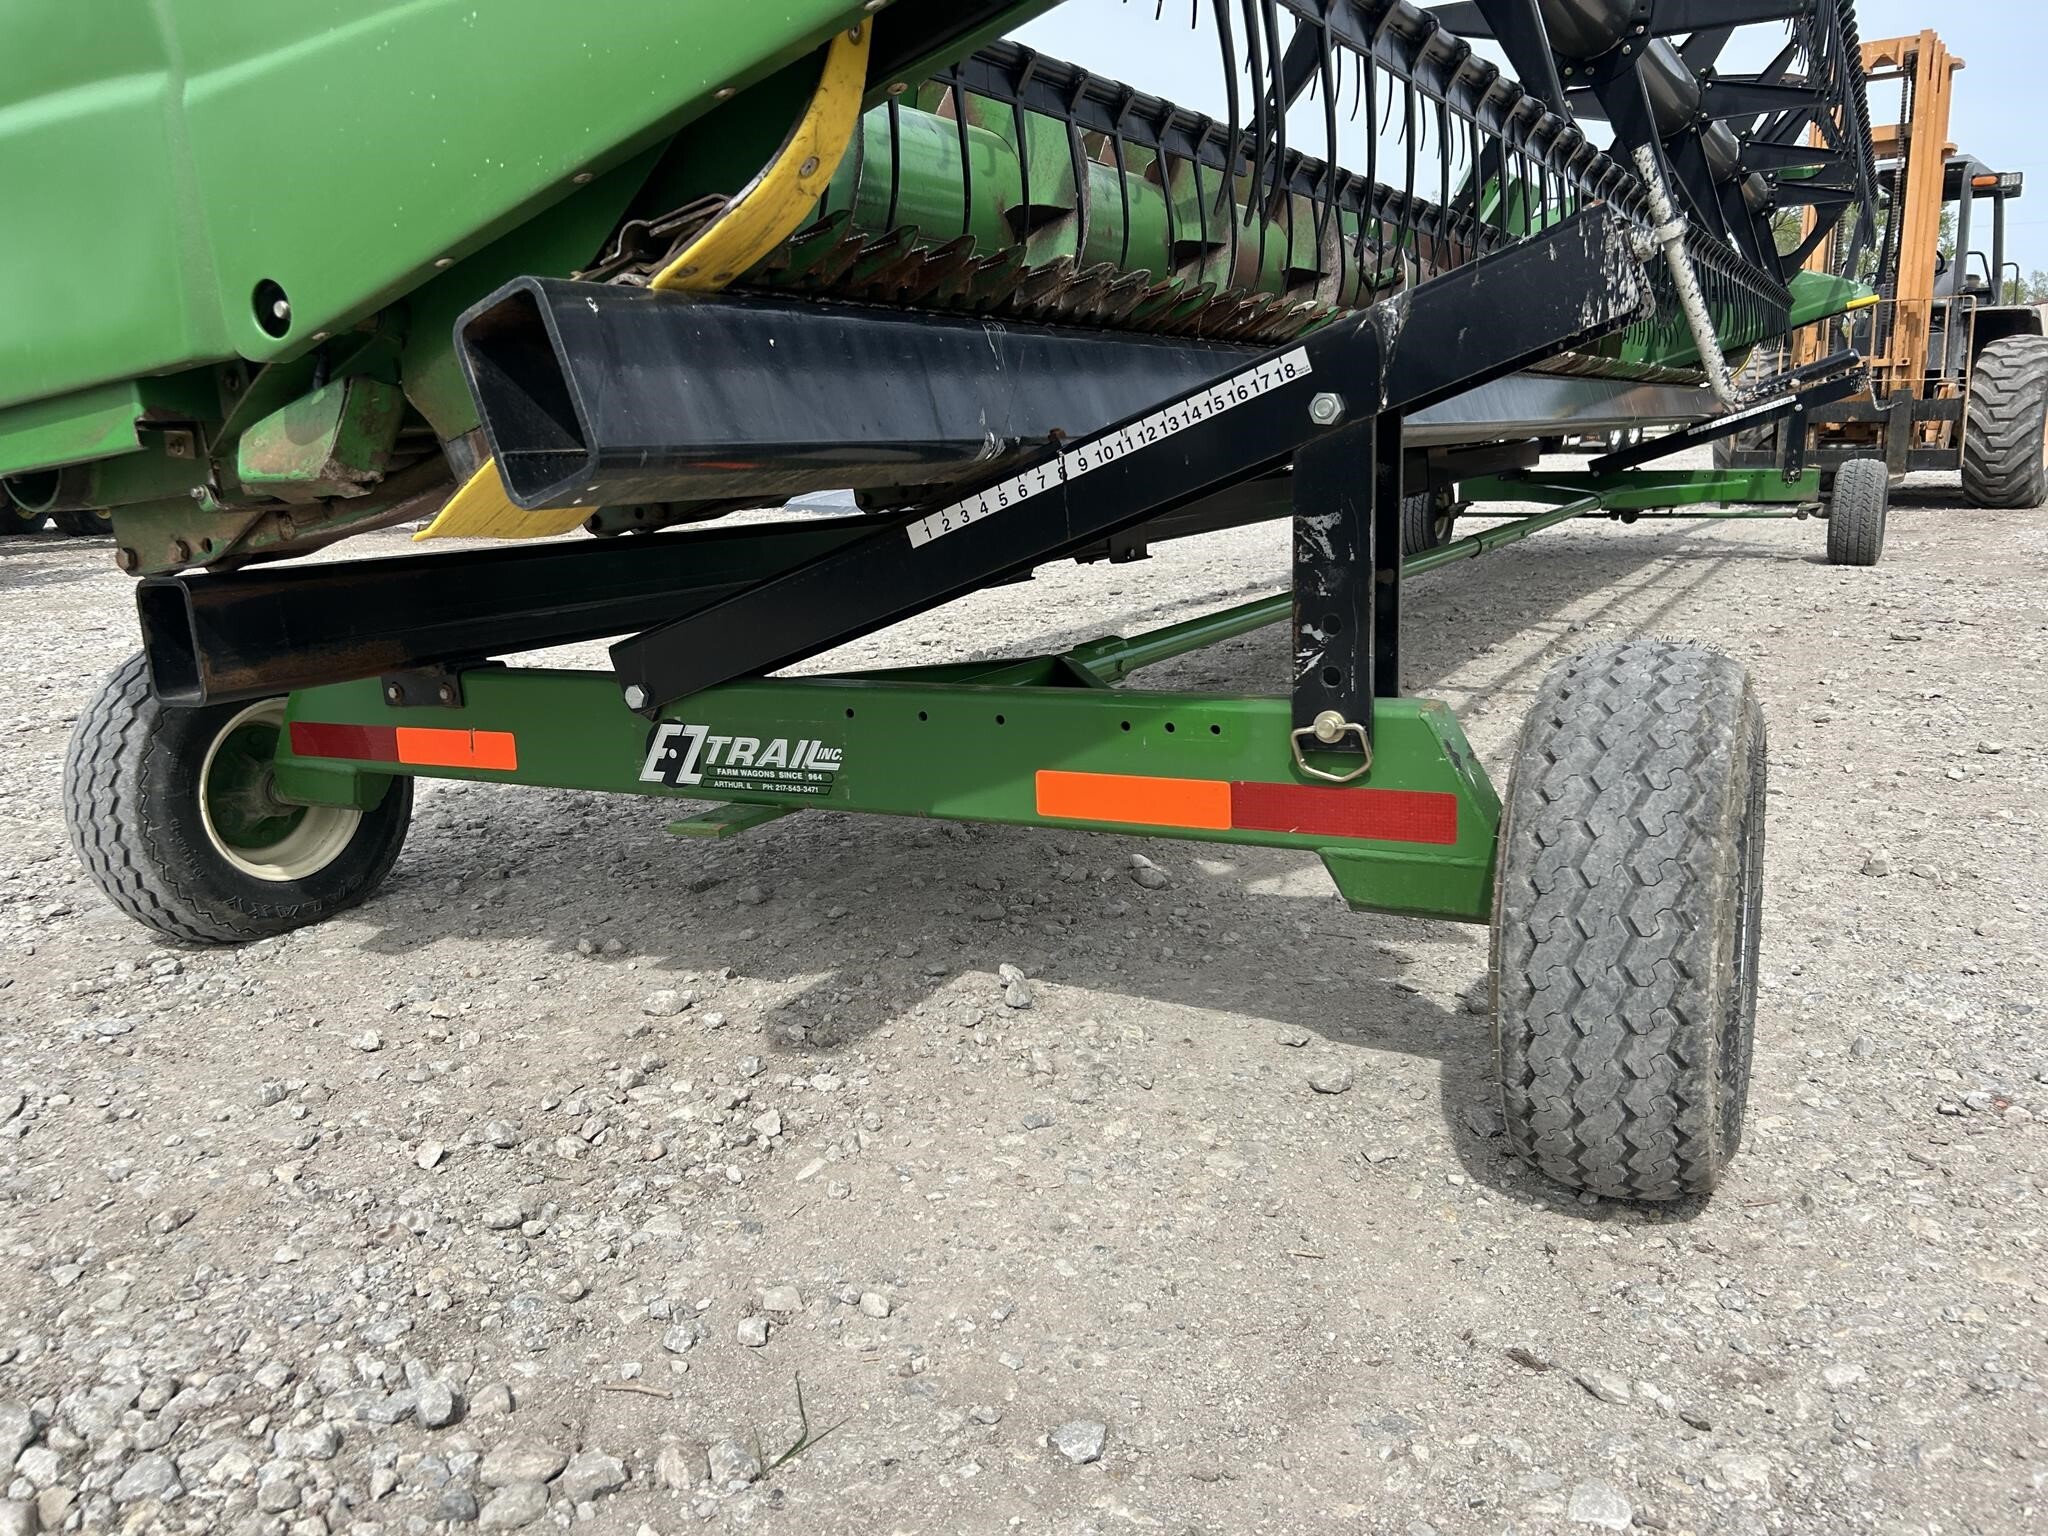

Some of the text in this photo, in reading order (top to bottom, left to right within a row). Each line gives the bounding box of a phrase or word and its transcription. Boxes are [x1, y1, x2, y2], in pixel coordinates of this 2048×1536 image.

[924, 526, 933, 539] 1
[941, 518, 952, 532] 2
[960, 509, 970, 524] 3
[980, 501, 989, 515] 4
[998, 493, 1008, 507] 5
[1017, 484, 1028, 498] 6
[1036, 475, 1046, 489] 7
[1057, 465, 1068, 480] 8
[1077, 457, 1088, 472] 9
[1094, 445, 1114, 464] 10
[1115, 436, 1134, 454] 11
[1137, 426, 1158, 445] 12
[1159, 416, 1180, 435] 13
[1181, 406, 1202, 425] 14
[1203, 395, 1225, 414] 15
[1226, 385, 1249, 404] 16
[1250, 374, 1270, 394] 17
[1274, 363, 1296, 383] 18
[706, 736, 841, 771] TRAIL
[817, 747, 843, 761] INC.
[717, 768, 823, 781] FARM WAGONS SINCE 964
[775, 784, 819, 793] 217-543-3471
